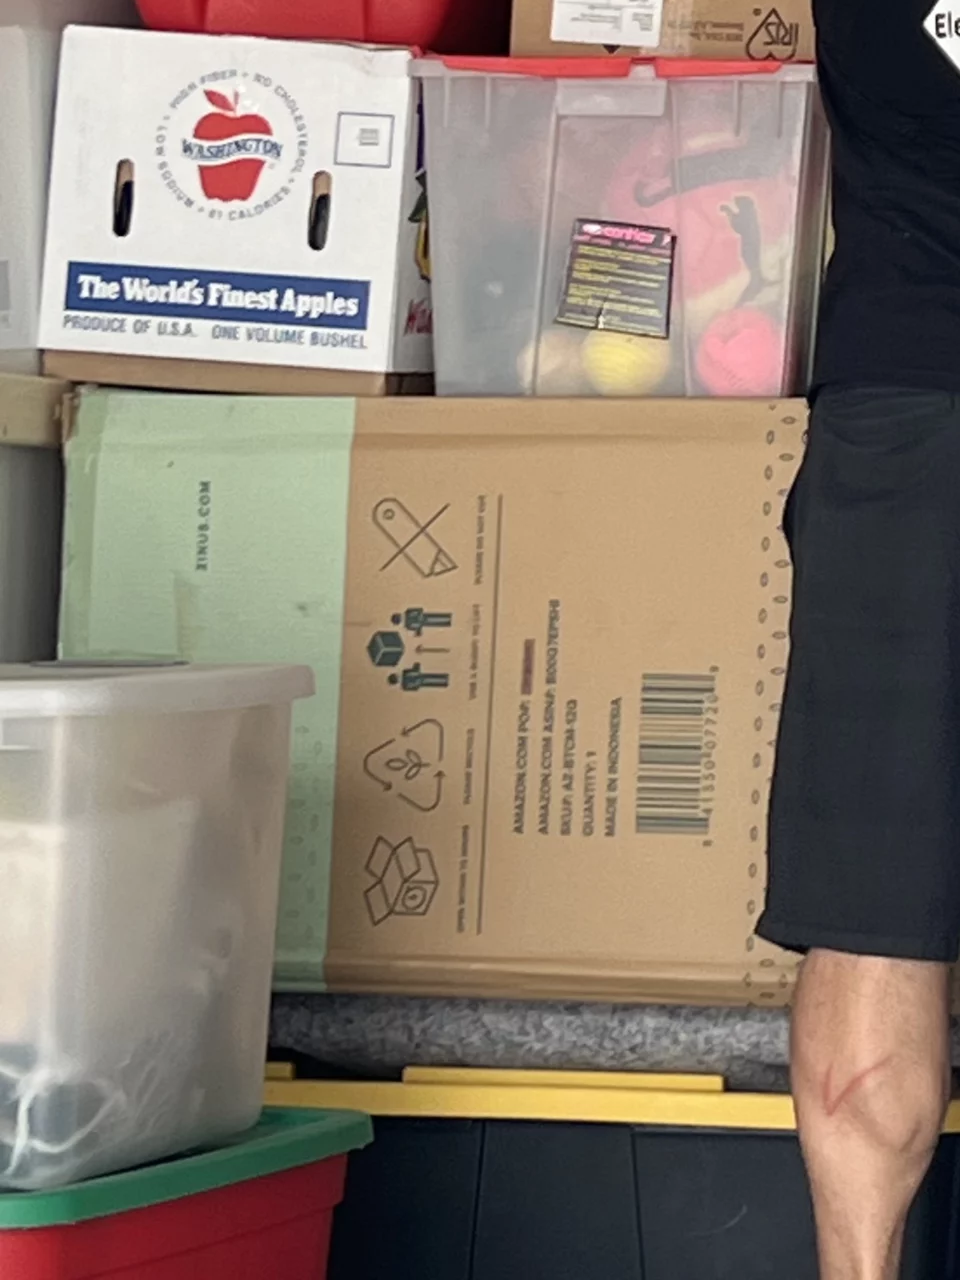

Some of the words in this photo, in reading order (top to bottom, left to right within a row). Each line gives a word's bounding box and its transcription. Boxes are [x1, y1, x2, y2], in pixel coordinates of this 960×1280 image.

[763, 22, 800, 46] IRIS
[181, 138, 284, 160] WASHINGTON
[77, 274, 119, 299] The
[121, 277, 204, 306] World's
[206, 283, 278, 311] Finest
[281, 288, 360, 319] Apples
[62, 314, 126, 332] PRODUCE
[132, 318, 151, 334] OF
[211, 324, 241, 342] ONE
[245, 326, 305, 346] VOLUME
[309, 329, 368, 350] BUSHEL
[195, 480, 211, 572] ZINUS.COM
[608, 696, 622, 774] INDONESIA
[511, 735, 528, 835] AMAZON.COM
[537, 736, 553, 836] AMAZON.COM
[582, 760, 596, 836] QUANTITY:
[606, 777, 619, 792] IN
[604, 795, 617, 837] MADE
